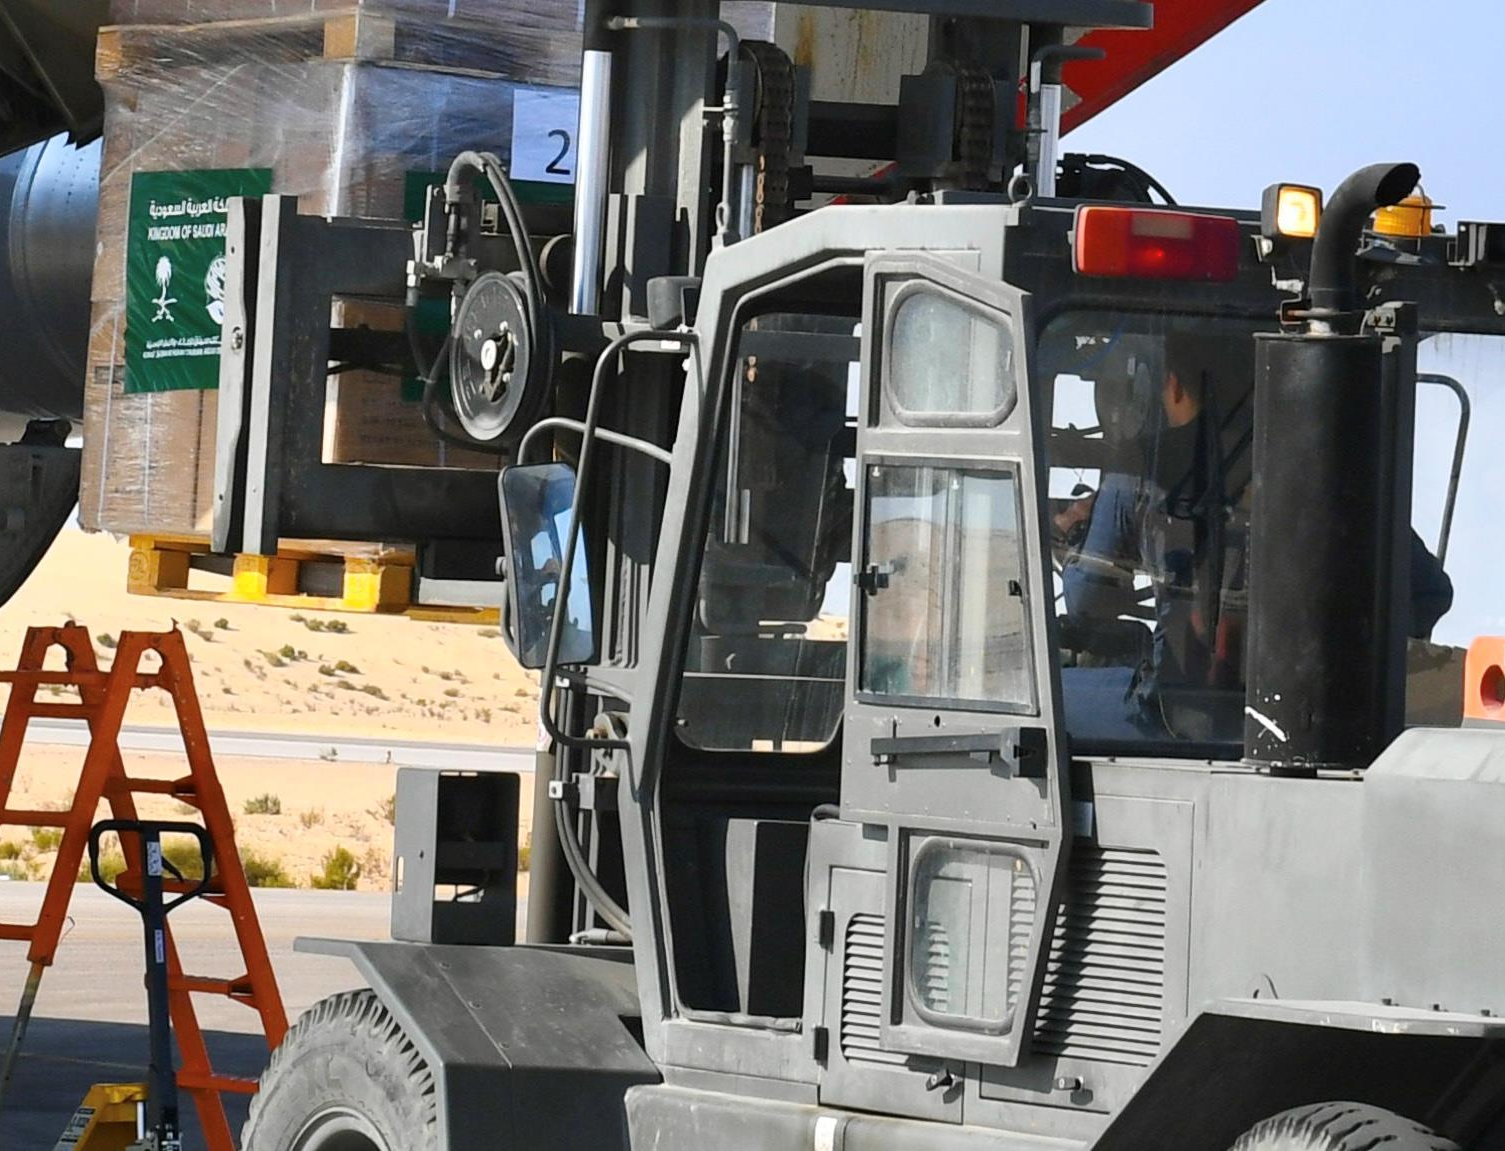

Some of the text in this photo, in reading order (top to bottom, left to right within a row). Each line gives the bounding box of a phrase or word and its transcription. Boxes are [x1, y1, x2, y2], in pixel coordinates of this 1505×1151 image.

[545, 129, 571, 176] 2
[149, 200, 187, 220] السعودية
[186, 197, 213, 218] العربية
[147, 226, 181, 241] KINGDOM
[181, 225, 192, 239] OF
[192, 223, 215, 238] SAUDI
